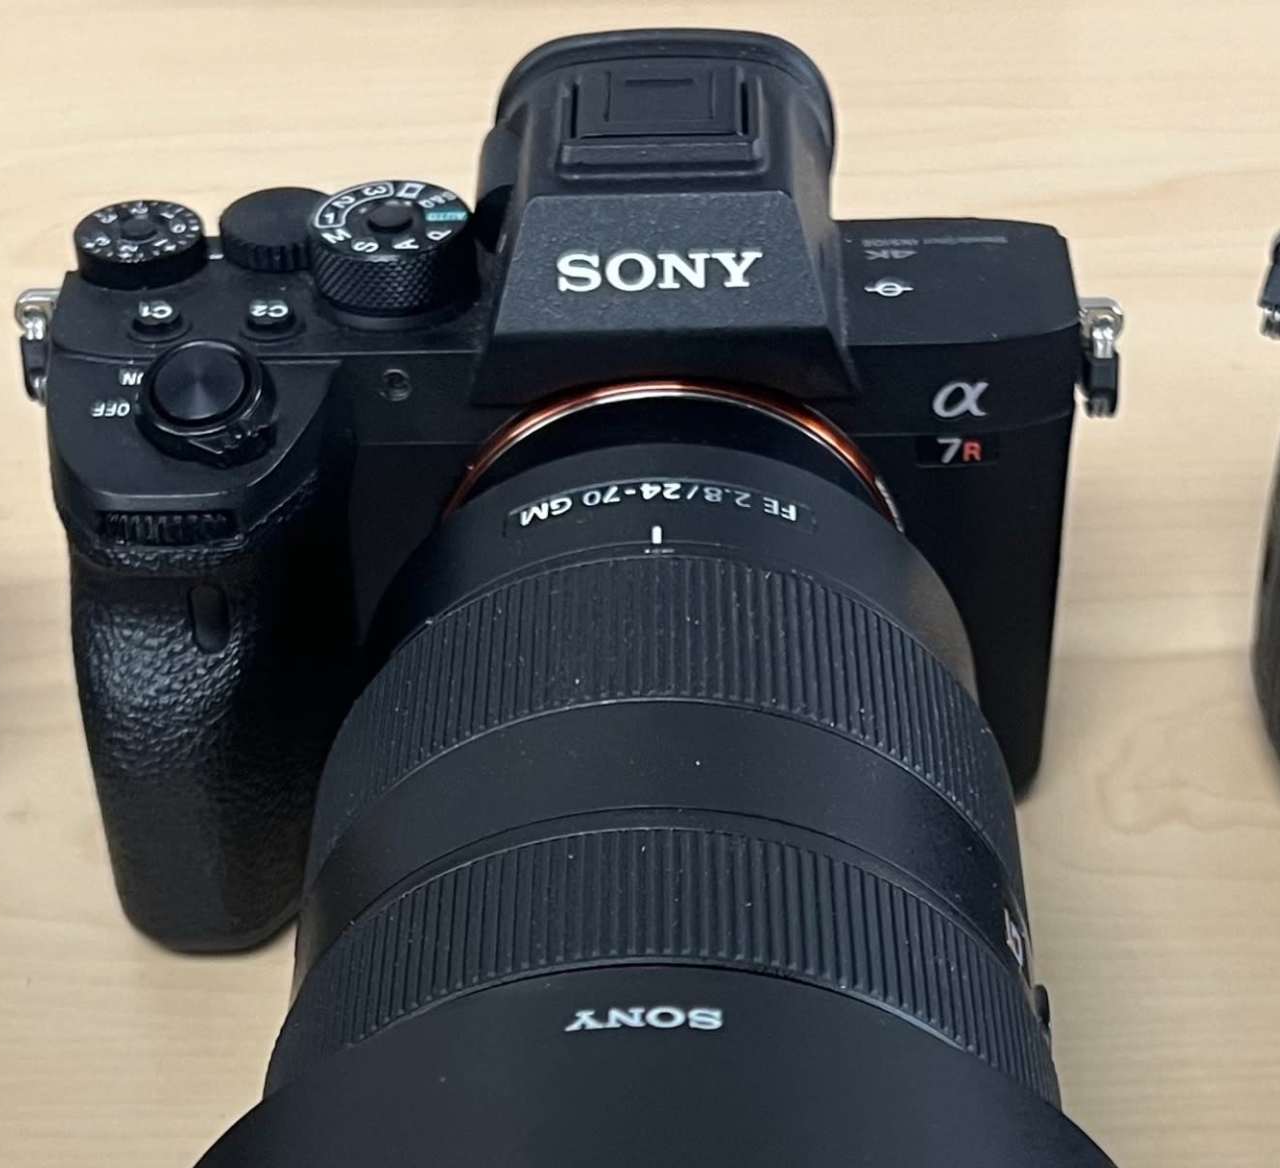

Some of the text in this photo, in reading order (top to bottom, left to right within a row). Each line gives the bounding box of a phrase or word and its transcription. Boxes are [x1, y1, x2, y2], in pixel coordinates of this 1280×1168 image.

[321, 228, 352, 244] M
[427, 230, 451, 241] P
[352, 241, 379, 253] S
[393, 238, 419, 249] A
[557, 250, 763, 292] SONY
[138, 304, 174, 319] C1
[250, 303, 288, 318] C2
[92, 402, 131, 417] OFF
[520, 482, 798, 526] FE 2.8/24-70 GM
[565, 1007, 724, 1032] SONY
